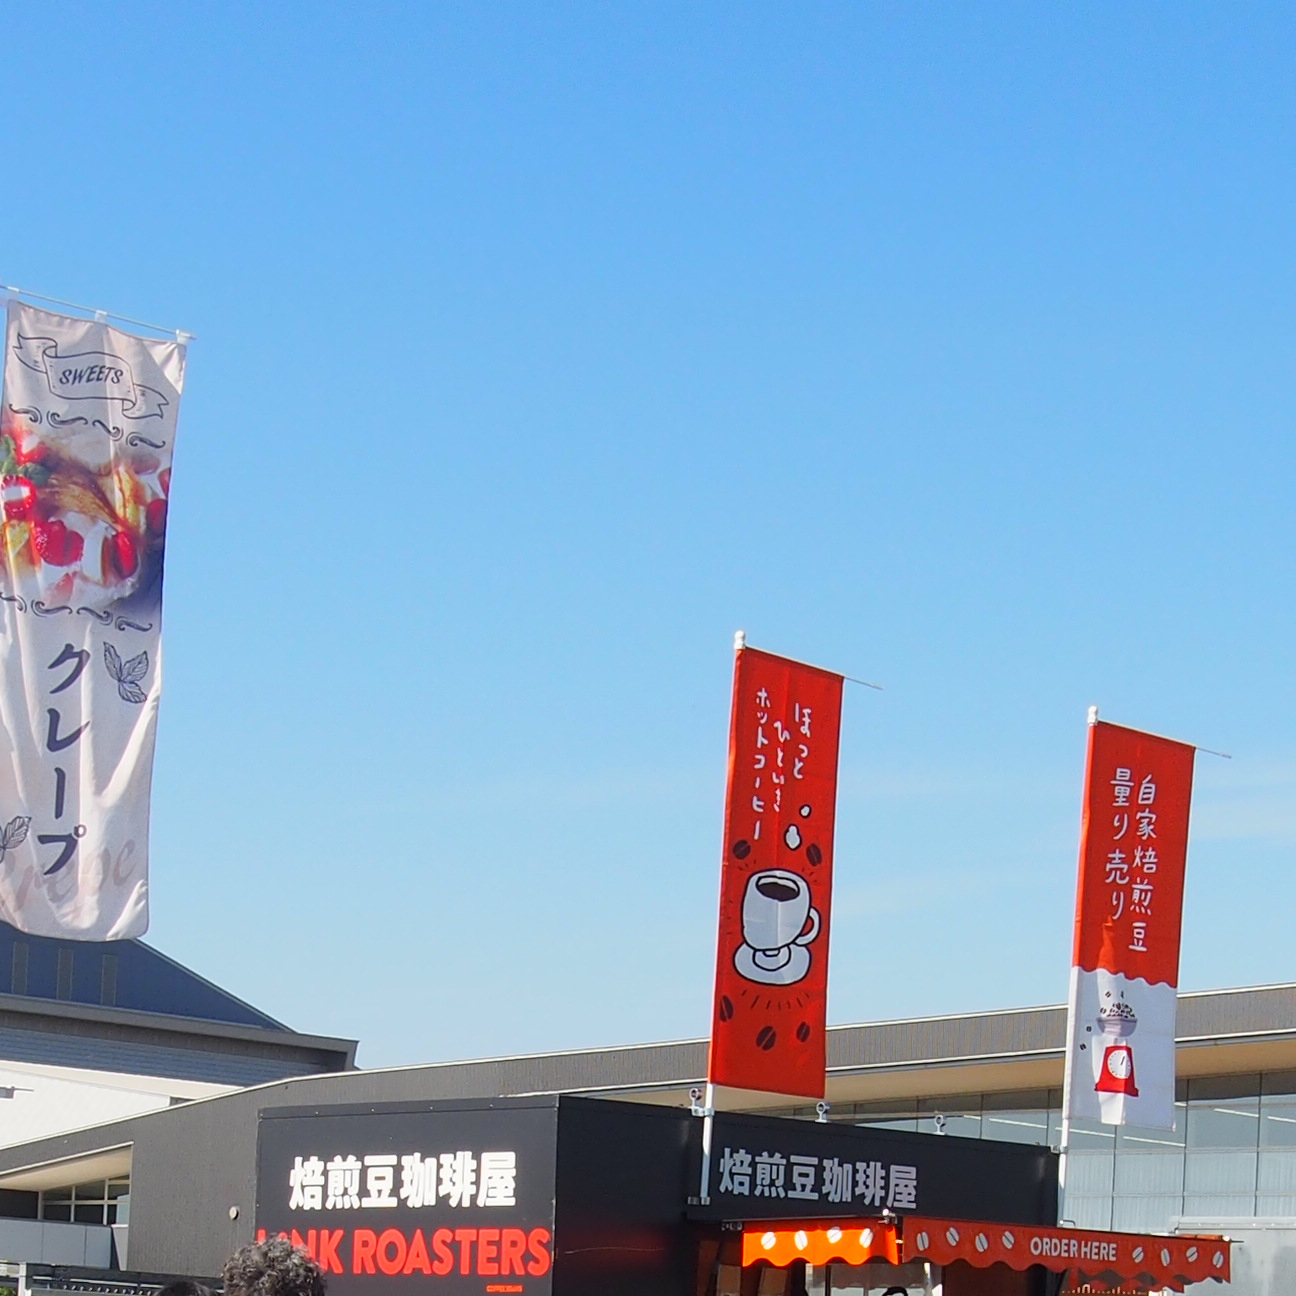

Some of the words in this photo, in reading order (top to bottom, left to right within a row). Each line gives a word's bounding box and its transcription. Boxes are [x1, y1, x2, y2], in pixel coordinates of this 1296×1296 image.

[59, 364, 124, 386] SWEETS
[38, 643, 91, 876] クレープ
[752, 687, 771, 841] ホットコーヒー
[772, 720, 791, 813] ひといき
[793, 702, 812, 780] ほっと
[1105, 767, 1135, 920] 量り売り
[1128, 774, 1158, 953] 自家焙煎豆
[288, 1150, 517, 1211] 焙煎豆珈琲屋
[719, 1147, 918, 1210] 焙煎豆珈琲屋
[353, 1227, 552, 1277] ROASTERS
[1030, 1236, 1078, 1260] ORDER
[1081, 1241, 1117, 1262] HERE
